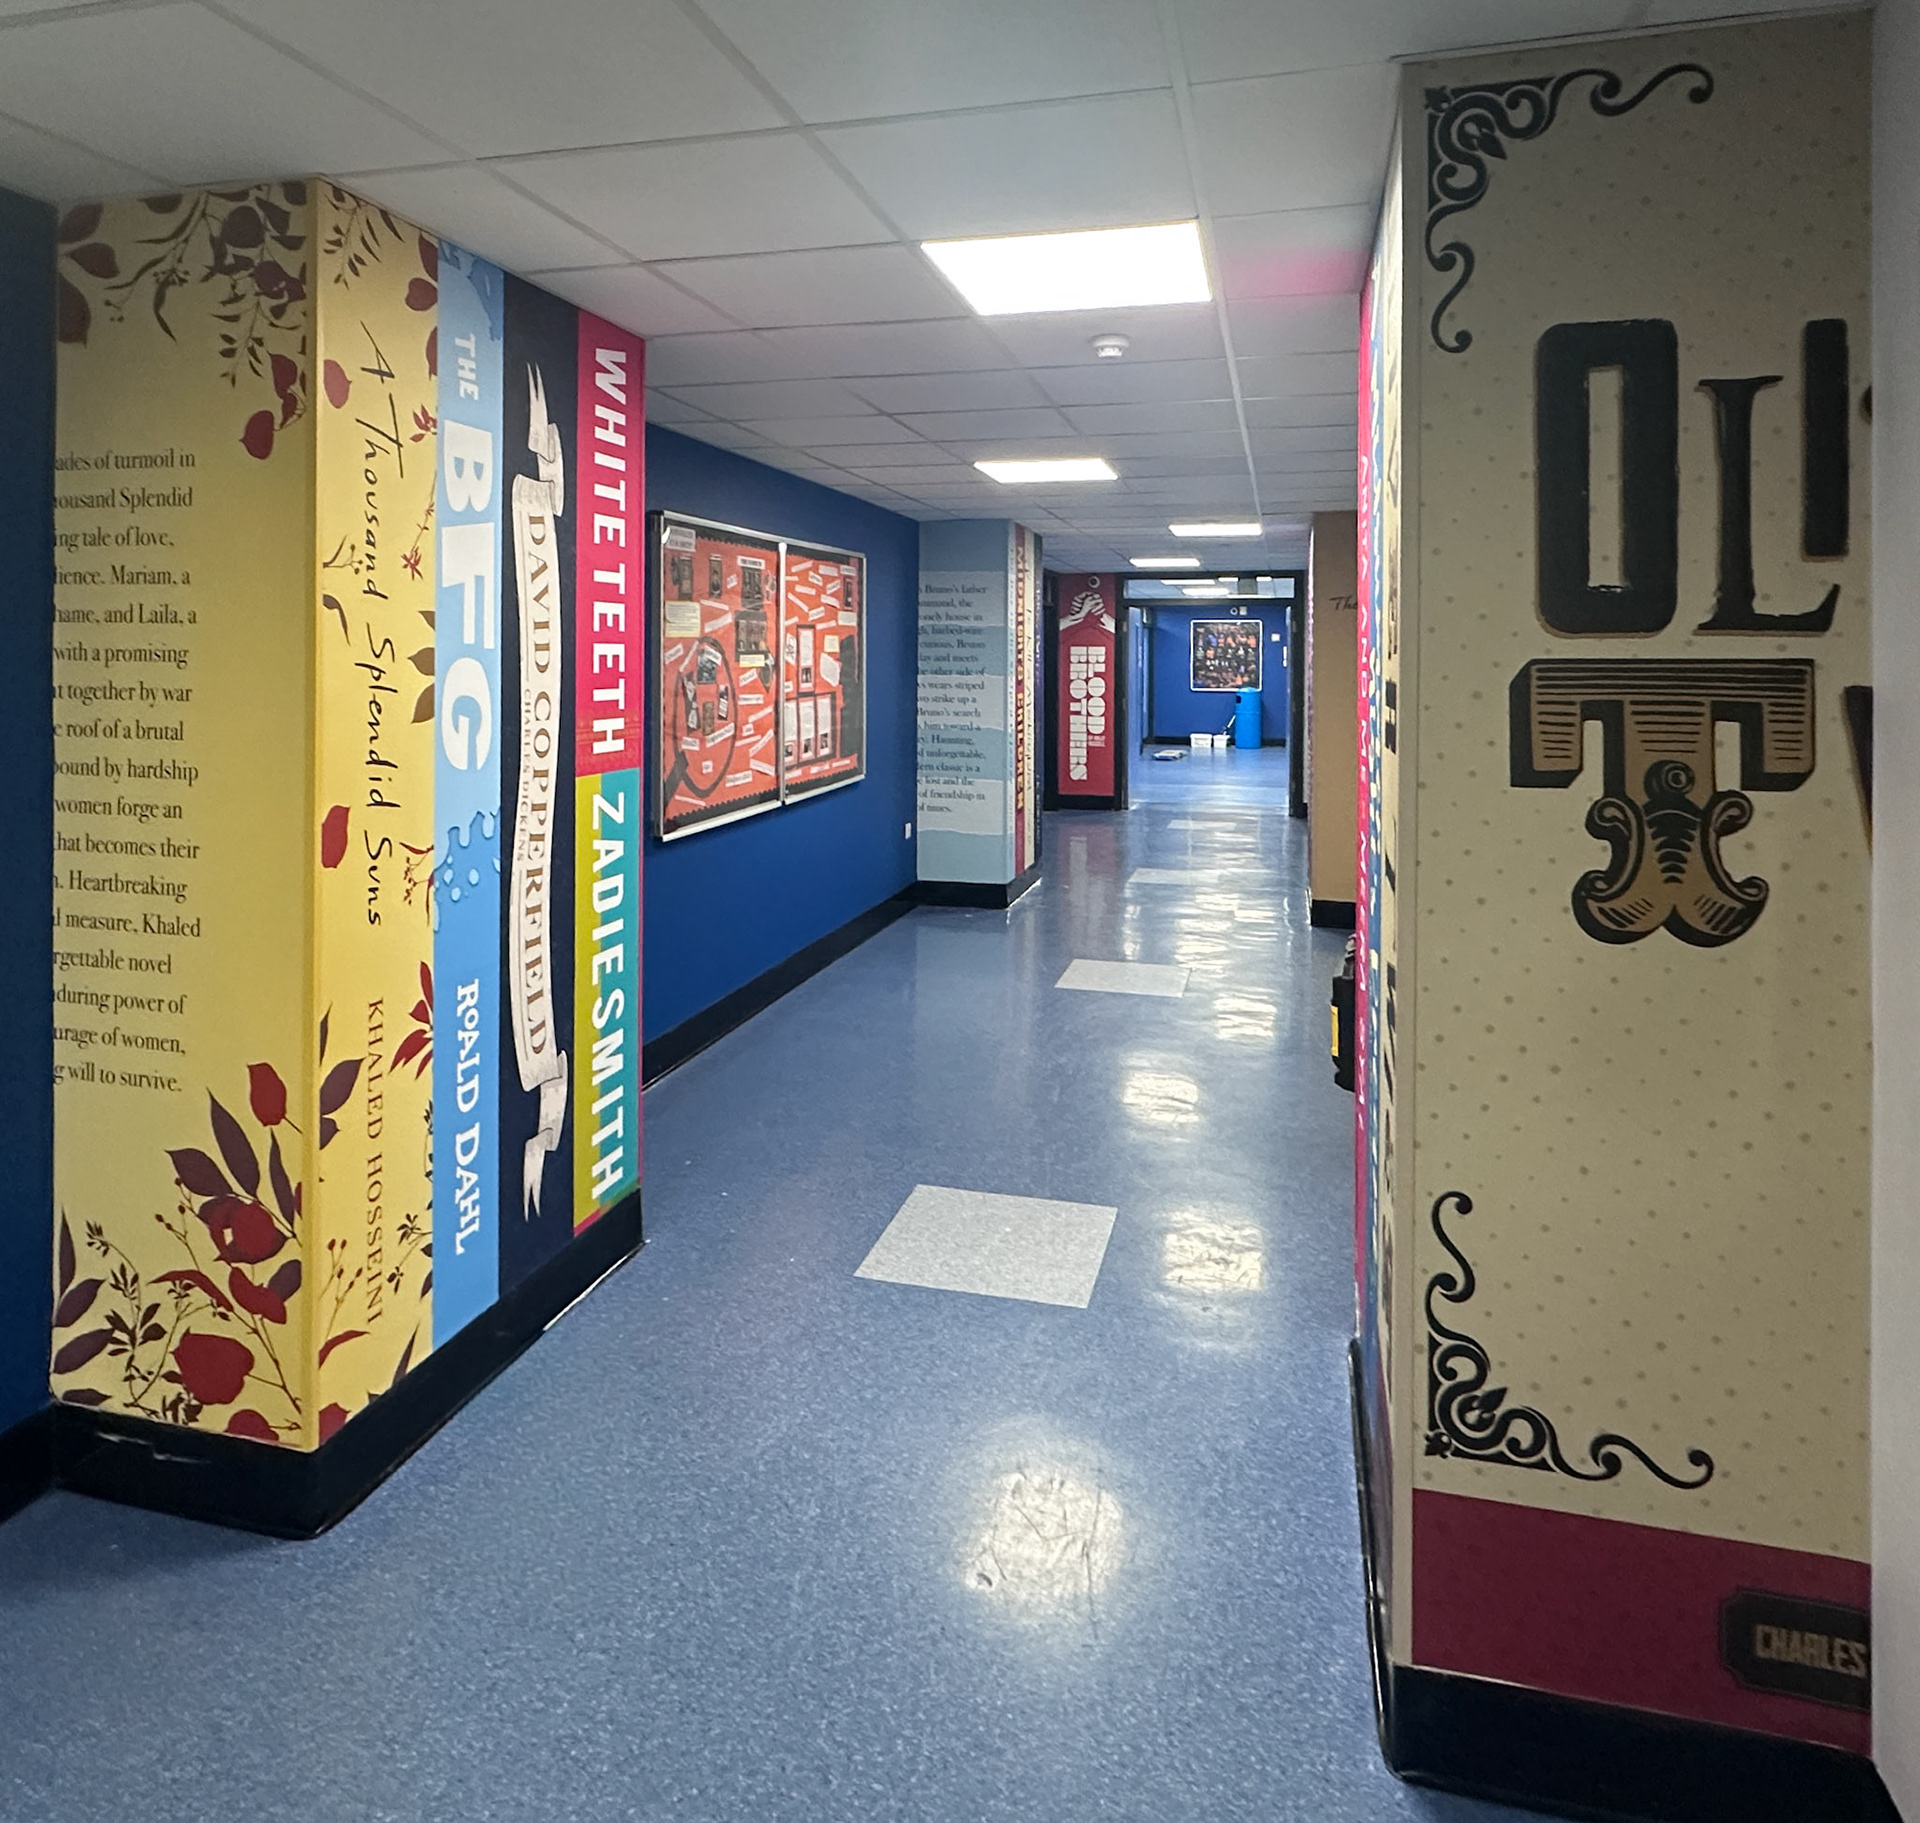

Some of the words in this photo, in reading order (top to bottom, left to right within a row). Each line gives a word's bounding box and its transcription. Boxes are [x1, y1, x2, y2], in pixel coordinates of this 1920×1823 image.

[360, 321, 395, 383] A
[455, 333, 478, 400] THE
[95, 450, 113, 470] of
[115, 448, 174, 469] turmoil
[179, 449, 195, 468] in
[593, 347, 627, 547] WHITE
[119, 487, 193, 514] Splendid
[355, 393, 404, 600] Thousand
[1533, 317, 1872, 640] OLI
[82, 527, 110, 547] tale
[115, 526, 133, 546] of
[182, 571, 191, 584] a
[442, 420, 497, 771] BFG
[529, 515, 550, 674] DAVID
[104, 603, 133, 624] and
[188, 610, 197, 624] a
[92, 648, 100, 661] a
[105, 642, 189, 670] promising
[593, 560, 626, 754] TEETH
[68, 680, 136, 706] together
[139, 681, 157, 708] by
[162, 688, 193, 702] war
[354, 622, 402, 808] Splendid
[1069, 646, 1087, 781] BROTHERS
[1087, 646, 1106, 735] BLOOD
[66, 718, 101, 738] roof
[102, 718, 122, 739] of
[123, 725, 132, 739] a
[136, 719, 184, 741] brutal
[521, 688, 531, 775] CHARLES
[104, 757, 122, 784] by
[128, 758, 199, 787] hardship
[55, 799, 112, 816] women
[117, 796, 159, 824] forge
[163, 803, 183, 819] an
[517, 779, 529, 862] DICKENS
[85, 833, 156, 856] becomes
[160, 837, 200, 860] their
[525, 691, 551, 1055] COPPERFIELD
[69, 869, 188, 904] Heartbreaking
[364, 830, 392, 926] Suns
[143, 913, 201, 937] Khaled
[128, 953, 171, 974] novel
[113, 994, 165, 1014] power
[168, 994, 187, 1014] of
[102, 1026, 120, 1046] of
[122, 1032, 186, 1055] women,
[366, 997, 384, 1140] KHALED
[456, 979, 481, 1113] ROALD
[68, 1061, 95, 1082] will
[100, 1068, 116, 1084] to
[119, 1070, 182, 1092] survive.
[454, 1134, 481, 1255] DAHL
[365, 1153, 384, 1323] HOSSEINI
[1754, 1624, 1868, 1680] CHARLES
